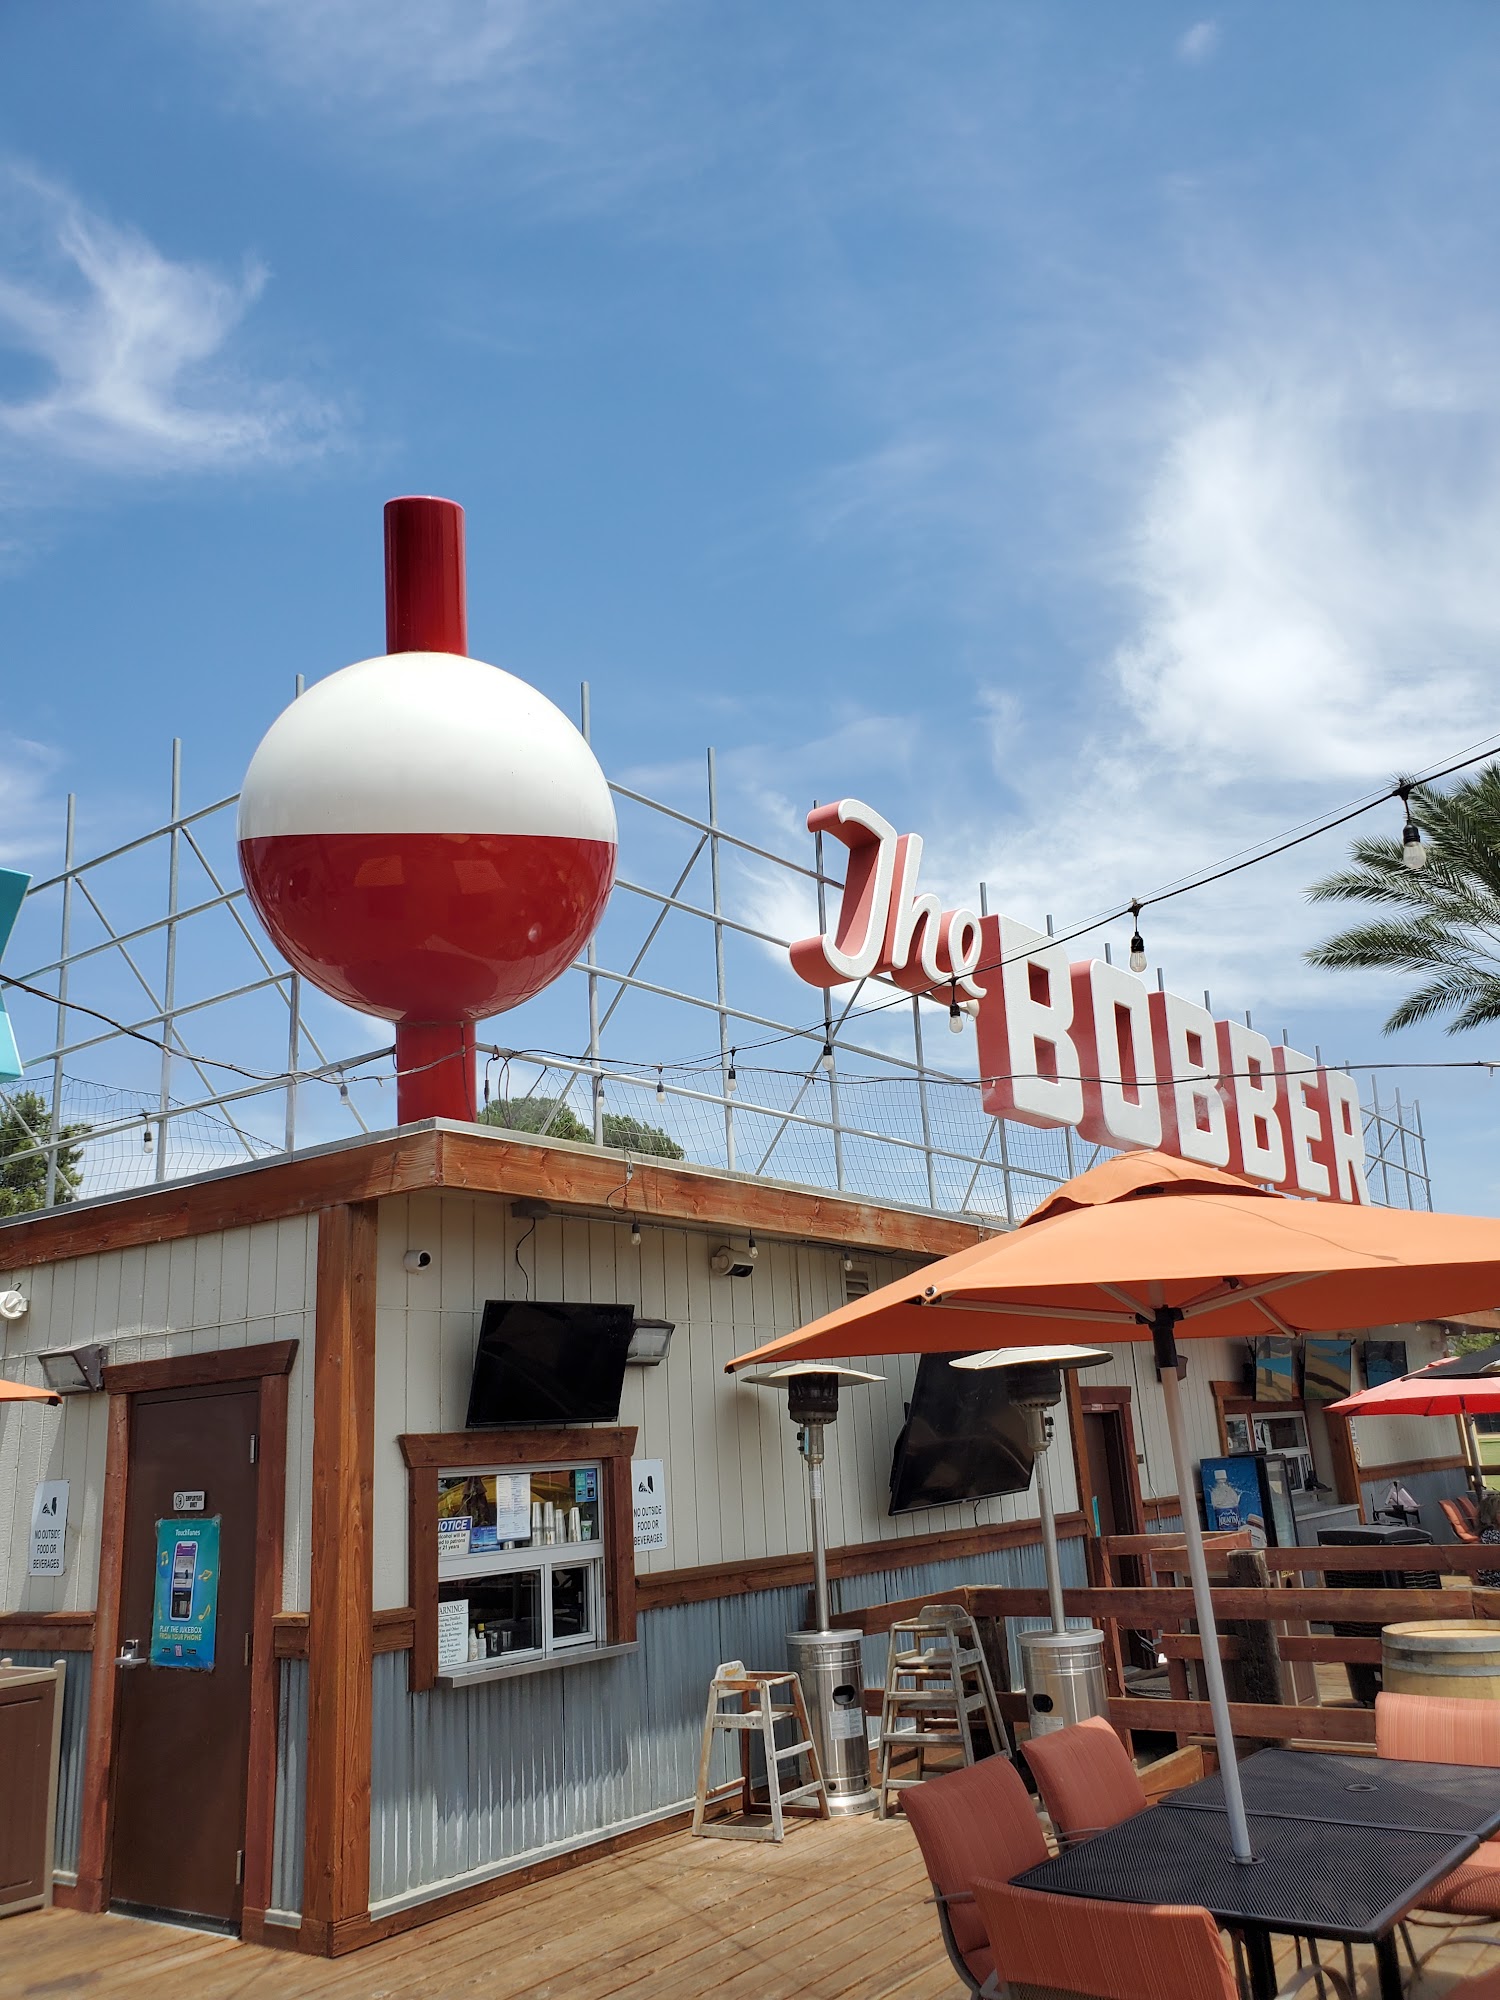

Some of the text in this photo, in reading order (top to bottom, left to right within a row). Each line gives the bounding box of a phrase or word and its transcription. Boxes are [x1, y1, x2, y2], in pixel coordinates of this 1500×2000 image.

[790, 799, 987, 1003] The
[978, 913, 1371, 1206] BOBBER
[634, 1505, 662, 1518] NO OUTSIDE
[637, 1519, 659, 1531] FOOD OR
[35, 1529, 61, 1539] NO OUTSIDE
[175, 1528, 201, 1537] TouchTunes
[634, 1532, 663, 1546] BEVERAGES
[37, 1544, 56, 1554] FOOD OR
[33, 1559, 60, 1569] BEVERAGES
[438, 1604, 464, 1614] ARNING:
[159, 1625, 203, 1634] PLAY THE JUKEBOX
[159, 1632, 171, 1640] FROM
[183, 1633, 203, 1641] PHONE
